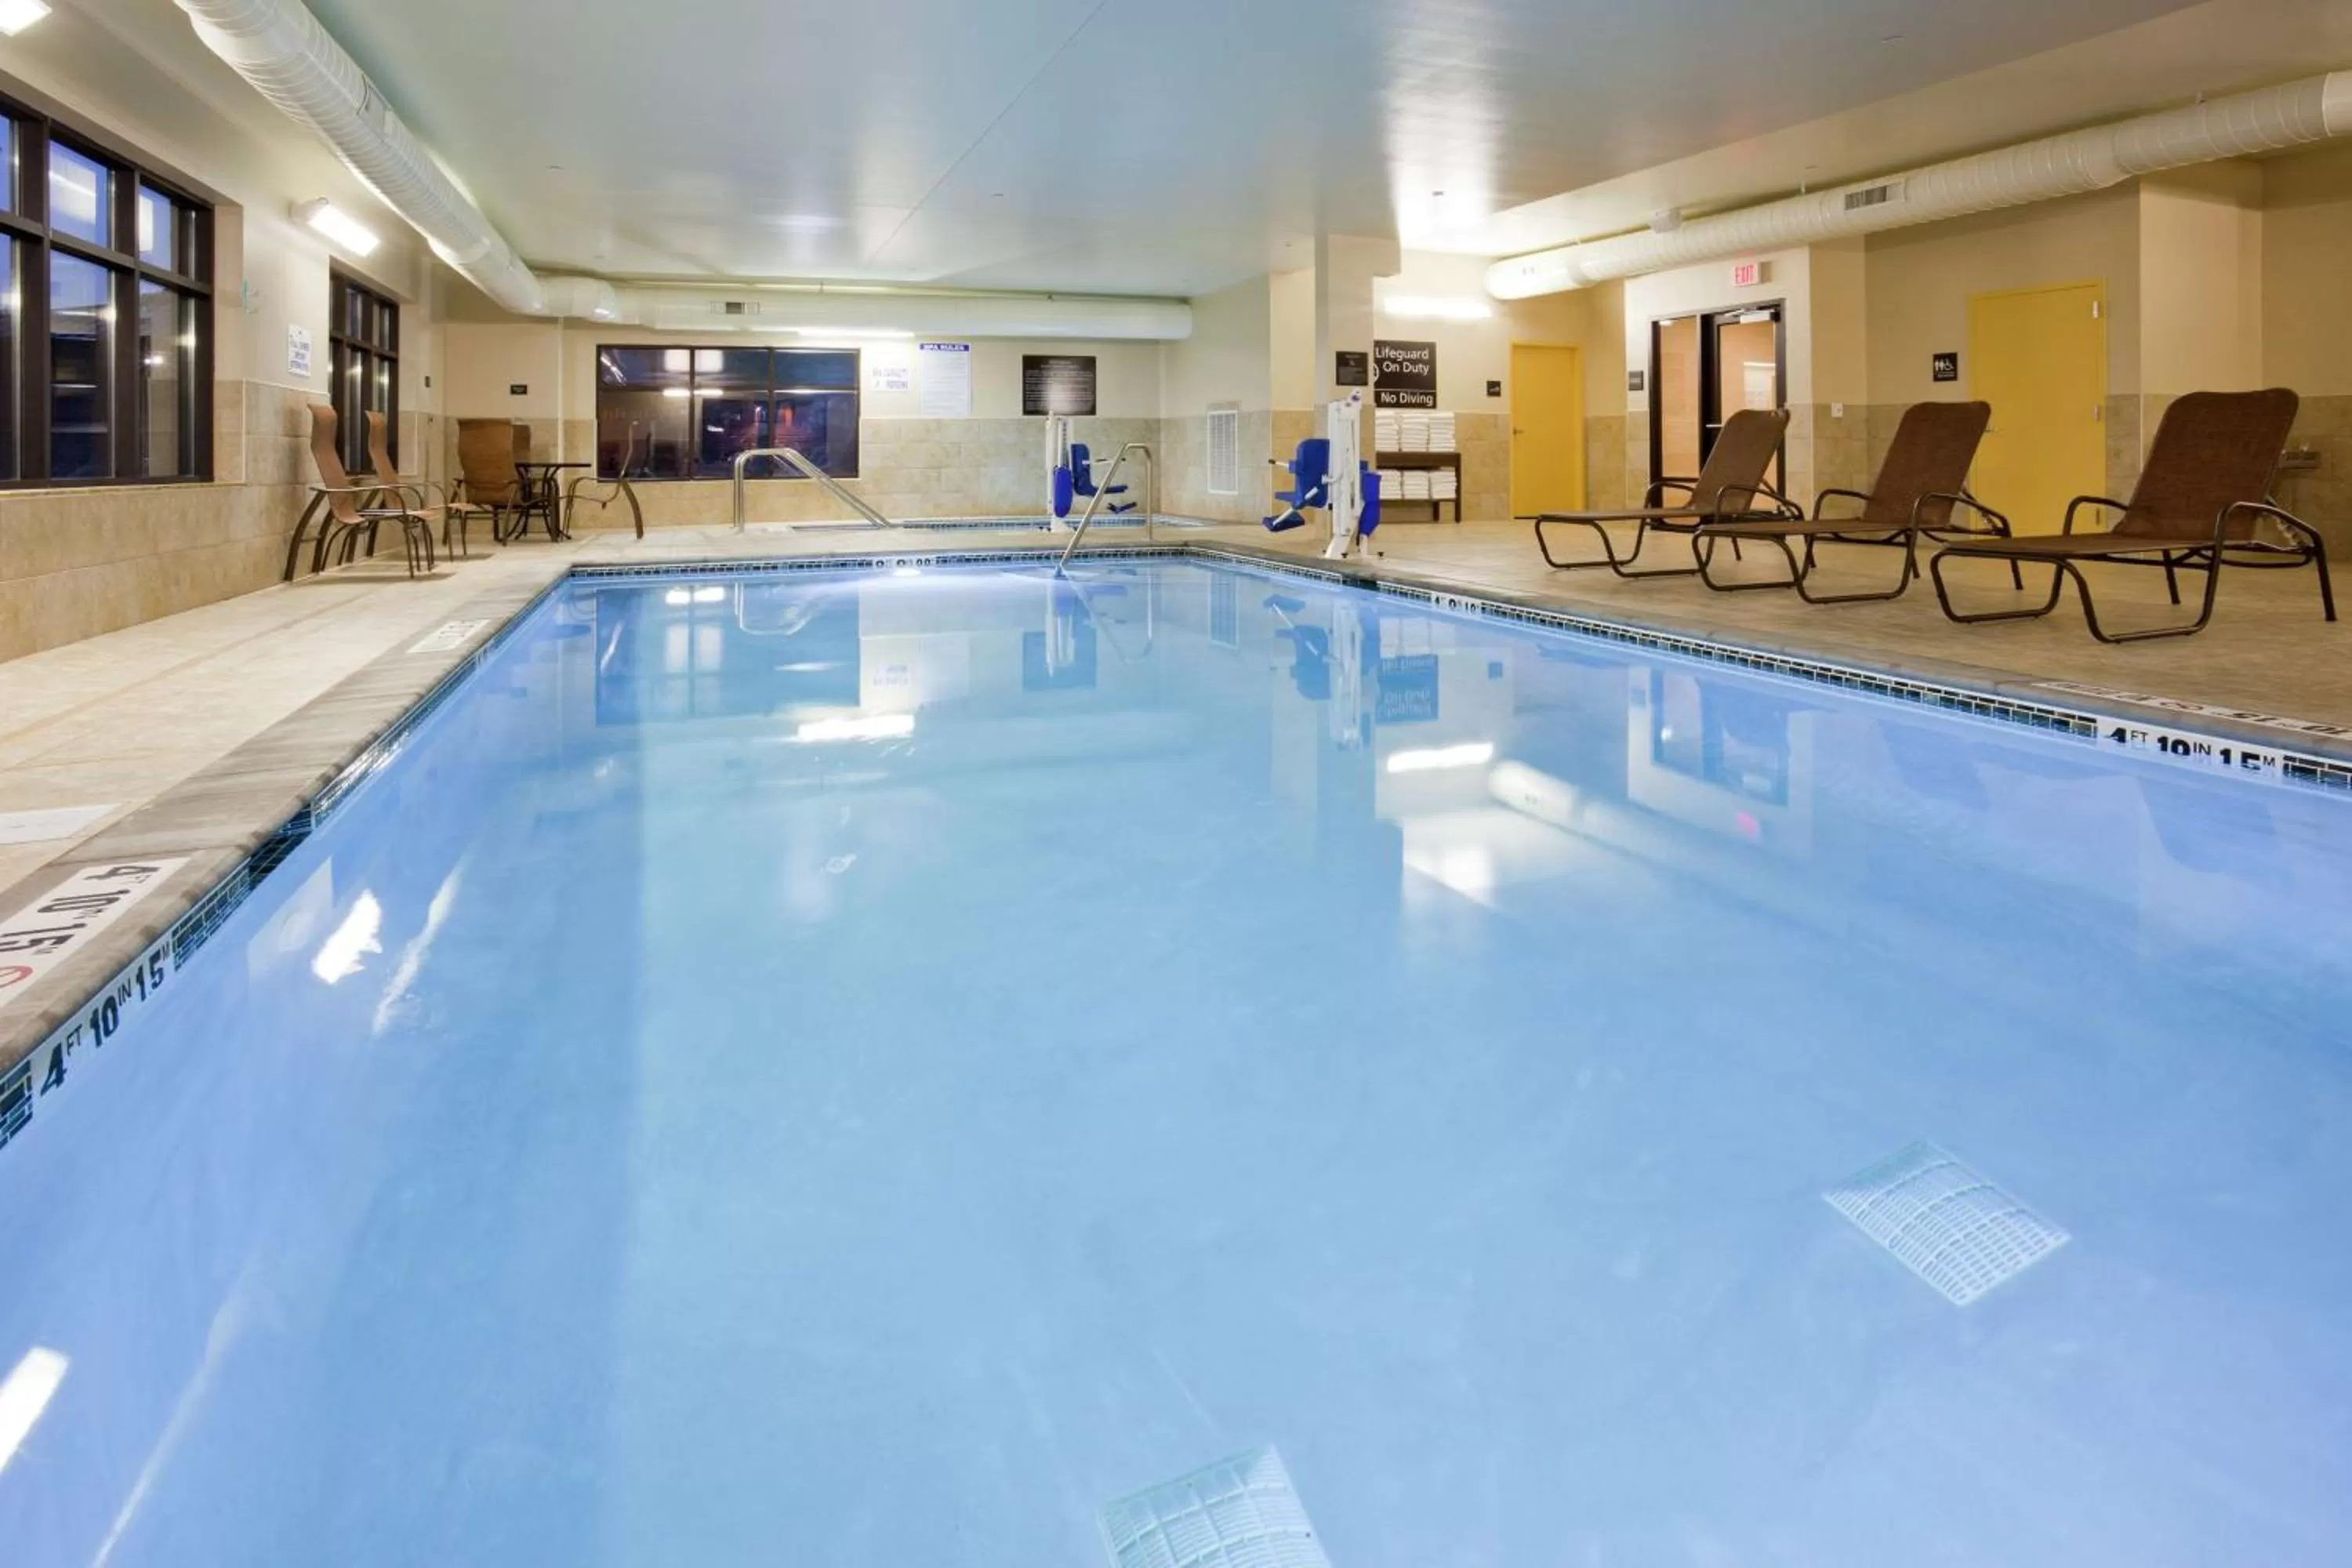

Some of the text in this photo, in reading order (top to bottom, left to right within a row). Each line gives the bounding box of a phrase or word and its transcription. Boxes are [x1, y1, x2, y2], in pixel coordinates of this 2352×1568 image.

[1734, 264, 1754, 285] EXIT
[1375, 347, 1429, 361] Lifeguard
[1382, 361, 1430, 376] On Duty
[1381, 392, 1434, 406] No Diving
[2105, 727, 2127, 744] 4
[2158, 735, 2191, 757] 10
[2193, 742, 2212, 756] IN
[2263, 755, 2276, 767] M
[40, 1041, 67, 1098] 4
[66, 1023, 83, 1057] FT
[89, 995, 119, 1048] 10
[118, 978, 132, 1007] IN
